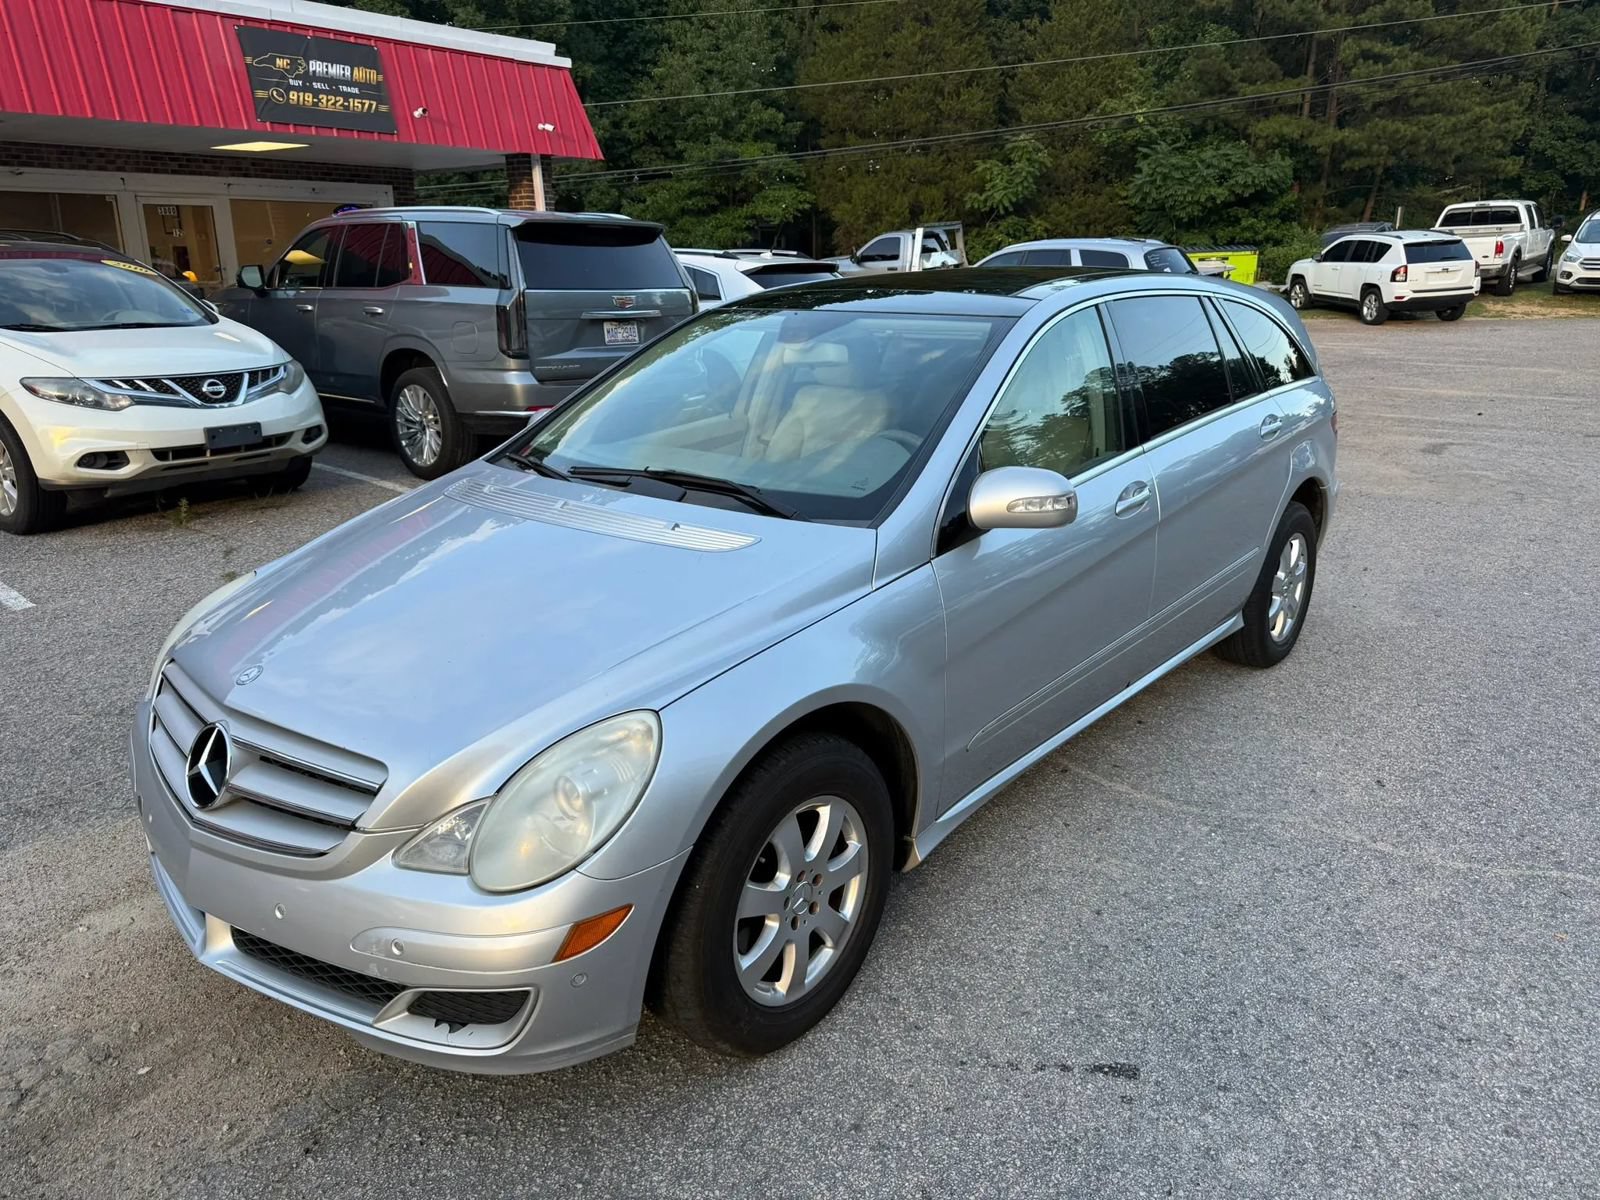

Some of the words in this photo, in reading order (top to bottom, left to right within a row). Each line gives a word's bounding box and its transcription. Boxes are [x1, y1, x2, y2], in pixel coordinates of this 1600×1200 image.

[275, 57, 290, 69] NC
[309, 59, 351, 80] PREMIER
[352, 66, 377, 85] AUTO
[288, 79, 303, 87] BUY
[312, 82, 330, 90] SELL
[338, 85, 360, 94] TRADE
[288, 90, 377, 113] 919-322-1577
